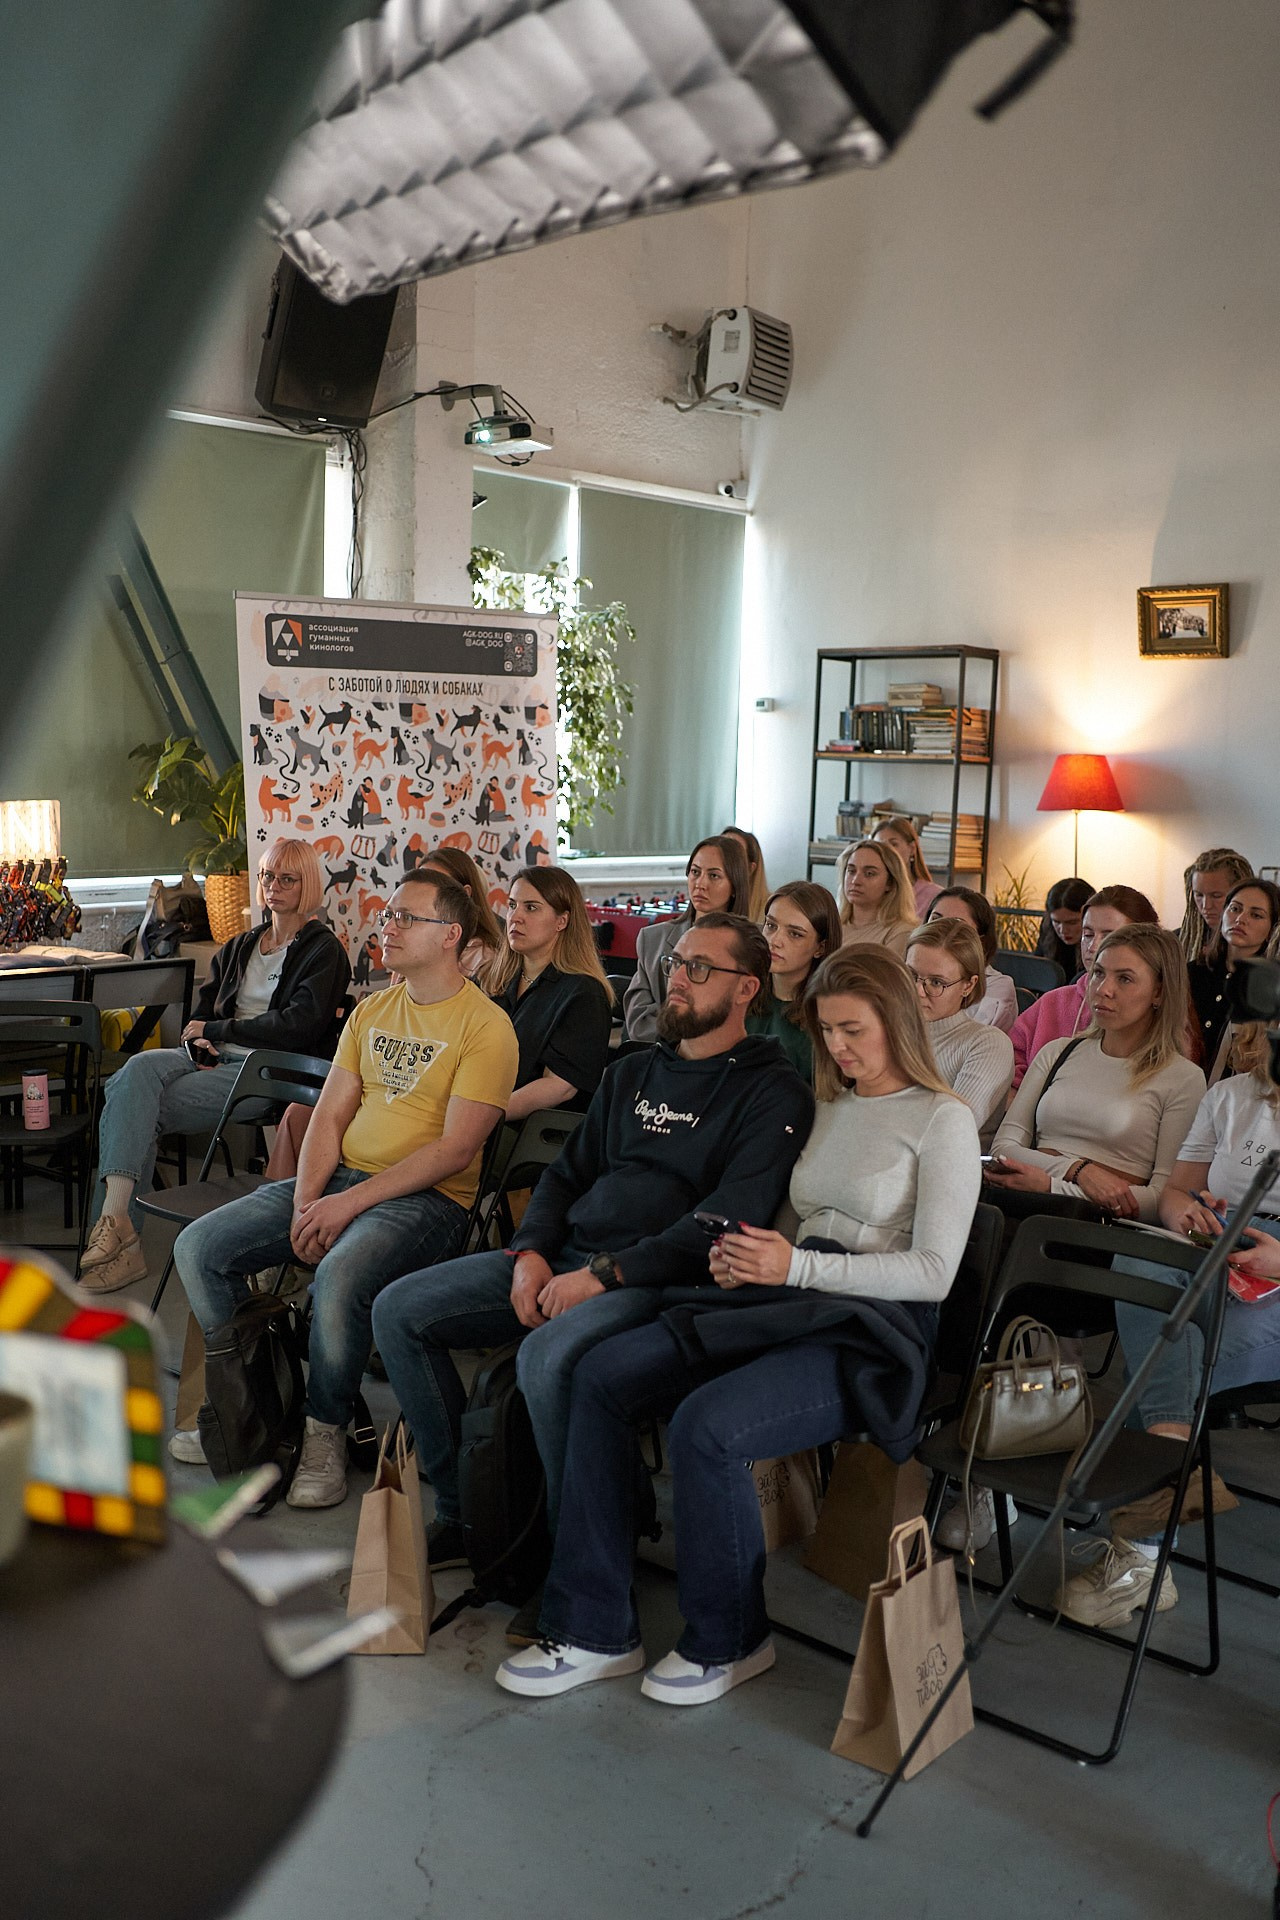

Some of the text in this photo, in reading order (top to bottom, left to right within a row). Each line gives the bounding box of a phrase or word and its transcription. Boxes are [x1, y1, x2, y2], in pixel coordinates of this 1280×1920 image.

[308, 624, 359, 634] ассоциация
[309, 634, 351, 643] гуманных
[465, 638, 504, 649] @AGK_DOG
[309, 643, 354, 652] кинологов
[328, 675, 484, 697] С ЗАБОТОЙ О ЛЮДЯХ И СОБАКАХ
[374, 1035, 434, 1070] GUESS
[635, 1099, 694, 1125] Pepe Jeans
